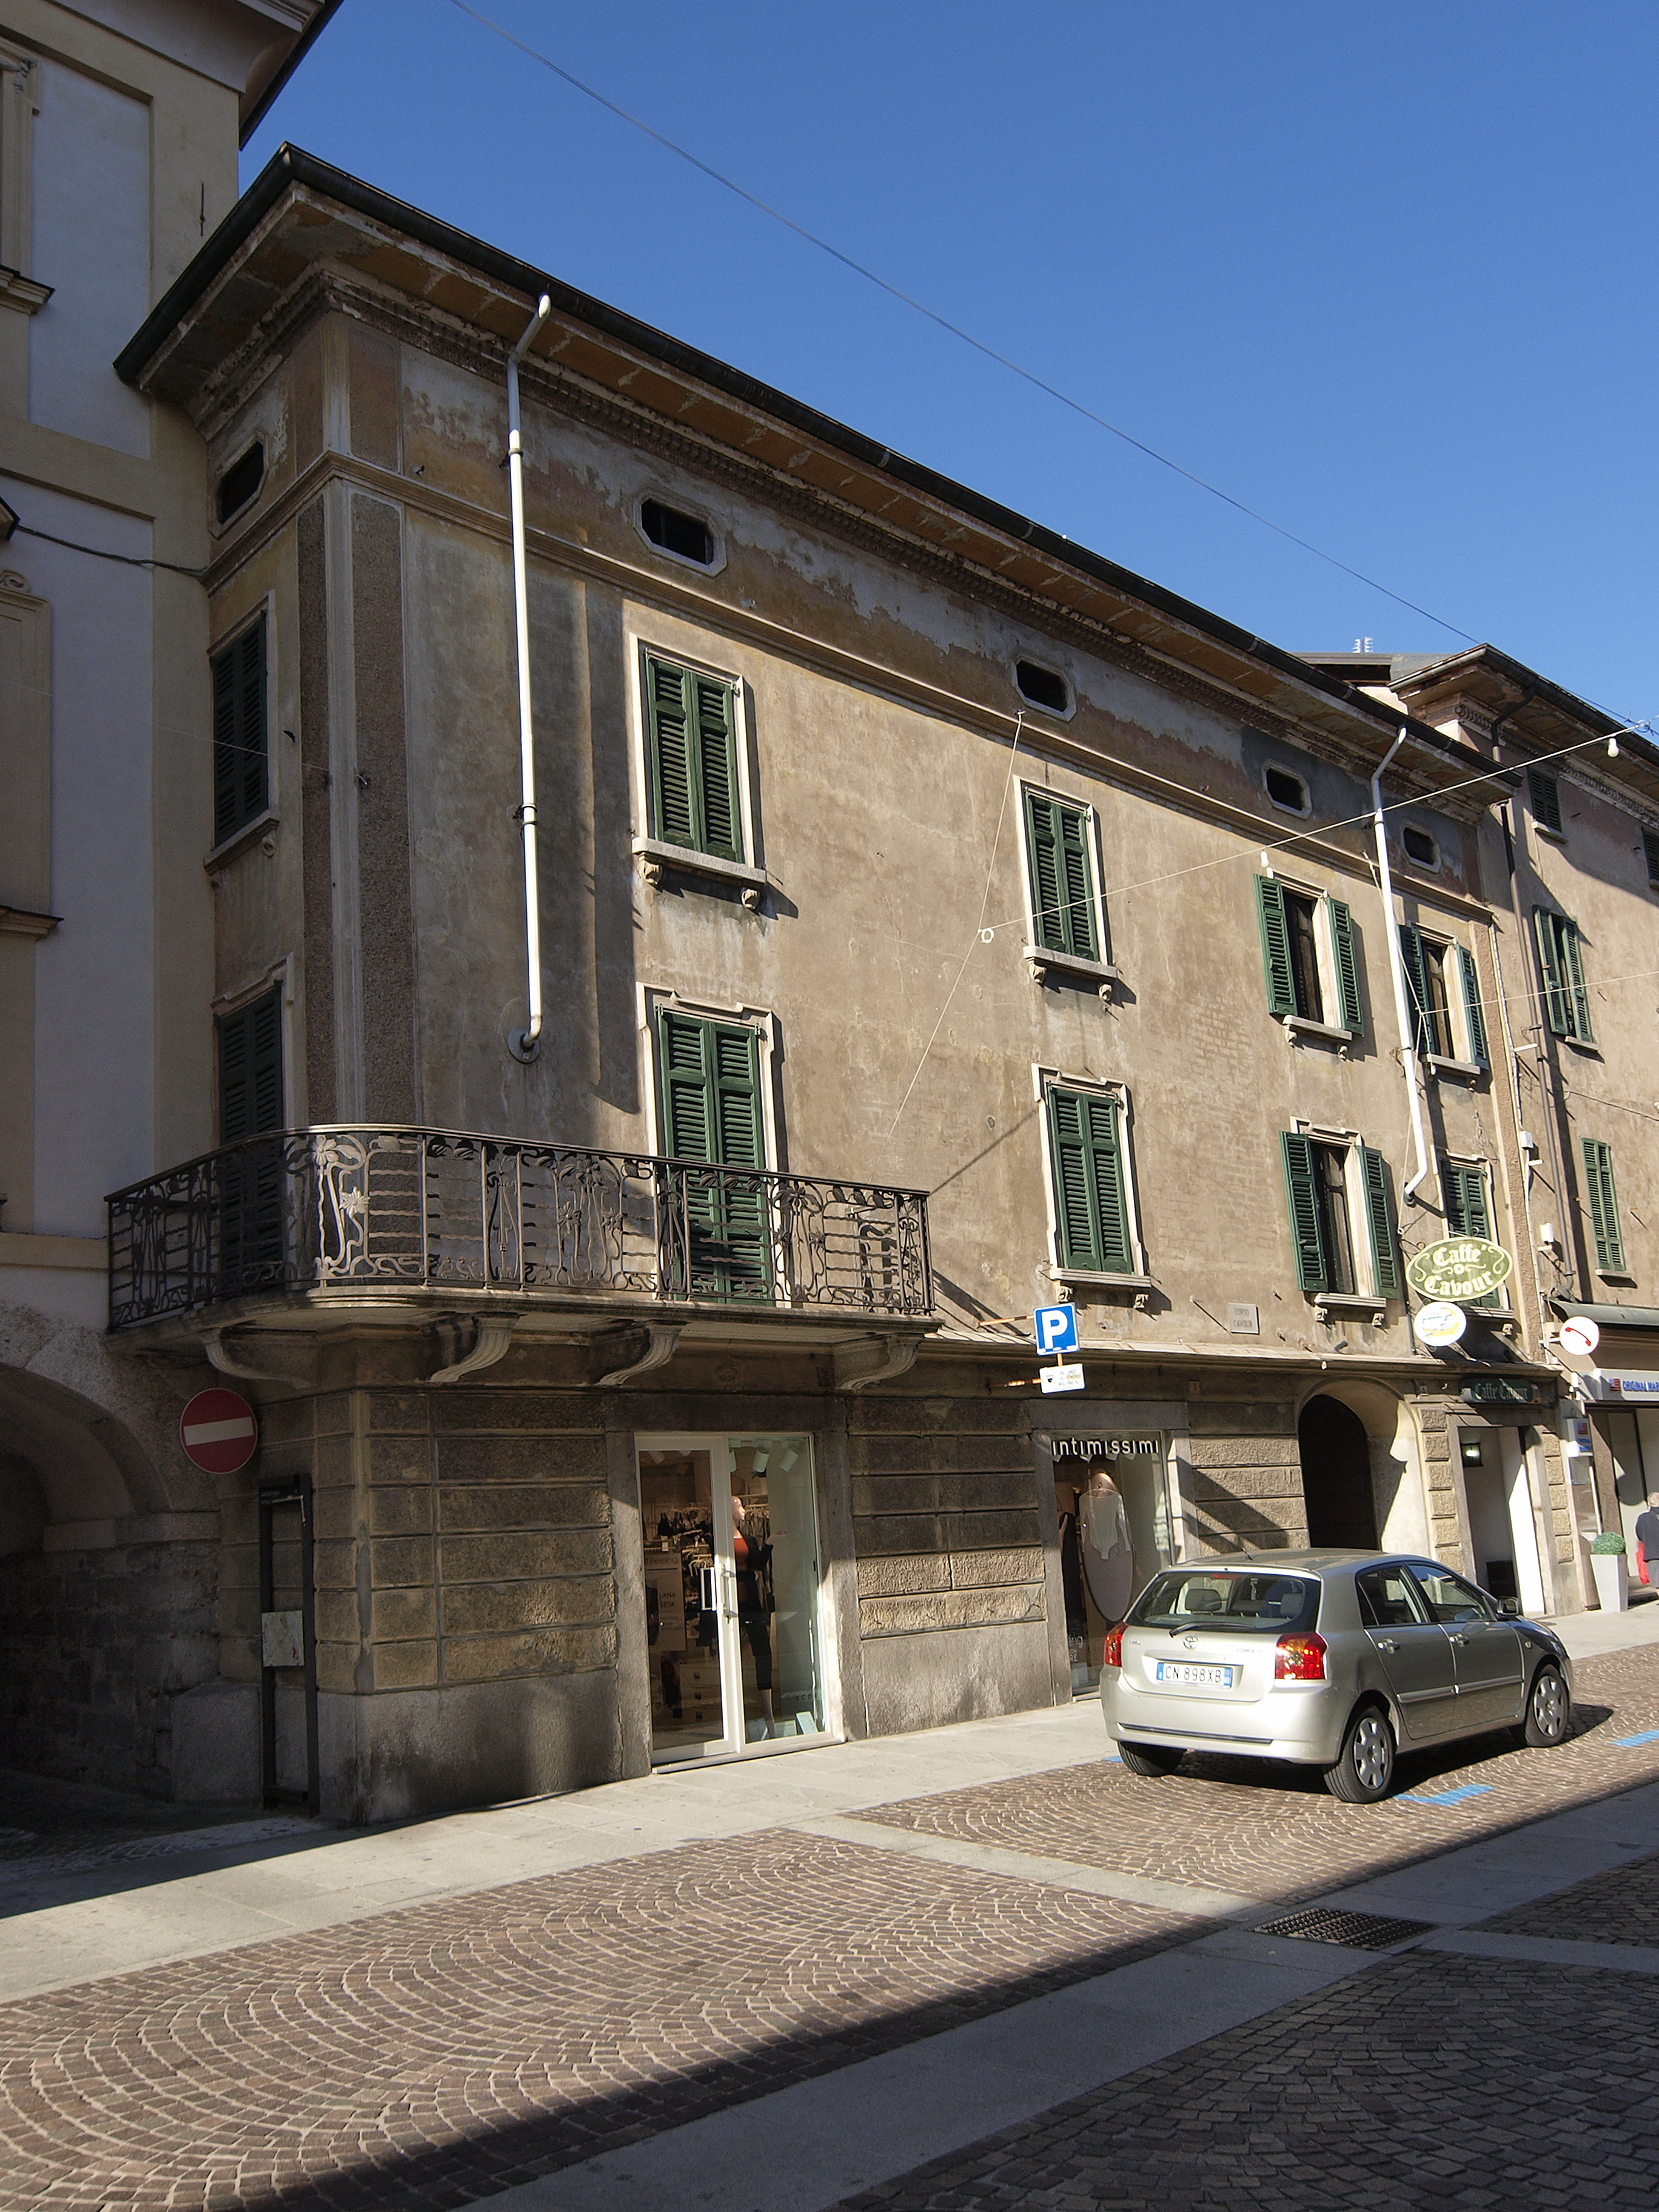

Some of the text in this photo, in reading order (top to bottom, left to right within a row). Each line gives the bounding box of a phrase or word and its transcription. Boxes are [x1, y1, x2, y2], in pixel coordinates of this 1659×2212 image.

[1424, 1271, 1493, 1296] Cavour
[1041, 1310, 1068, 1350] P
[1052, 1437, 1159, 1456] intimissimi
[1165, 1666, 1221, 1683] CN 898XB
